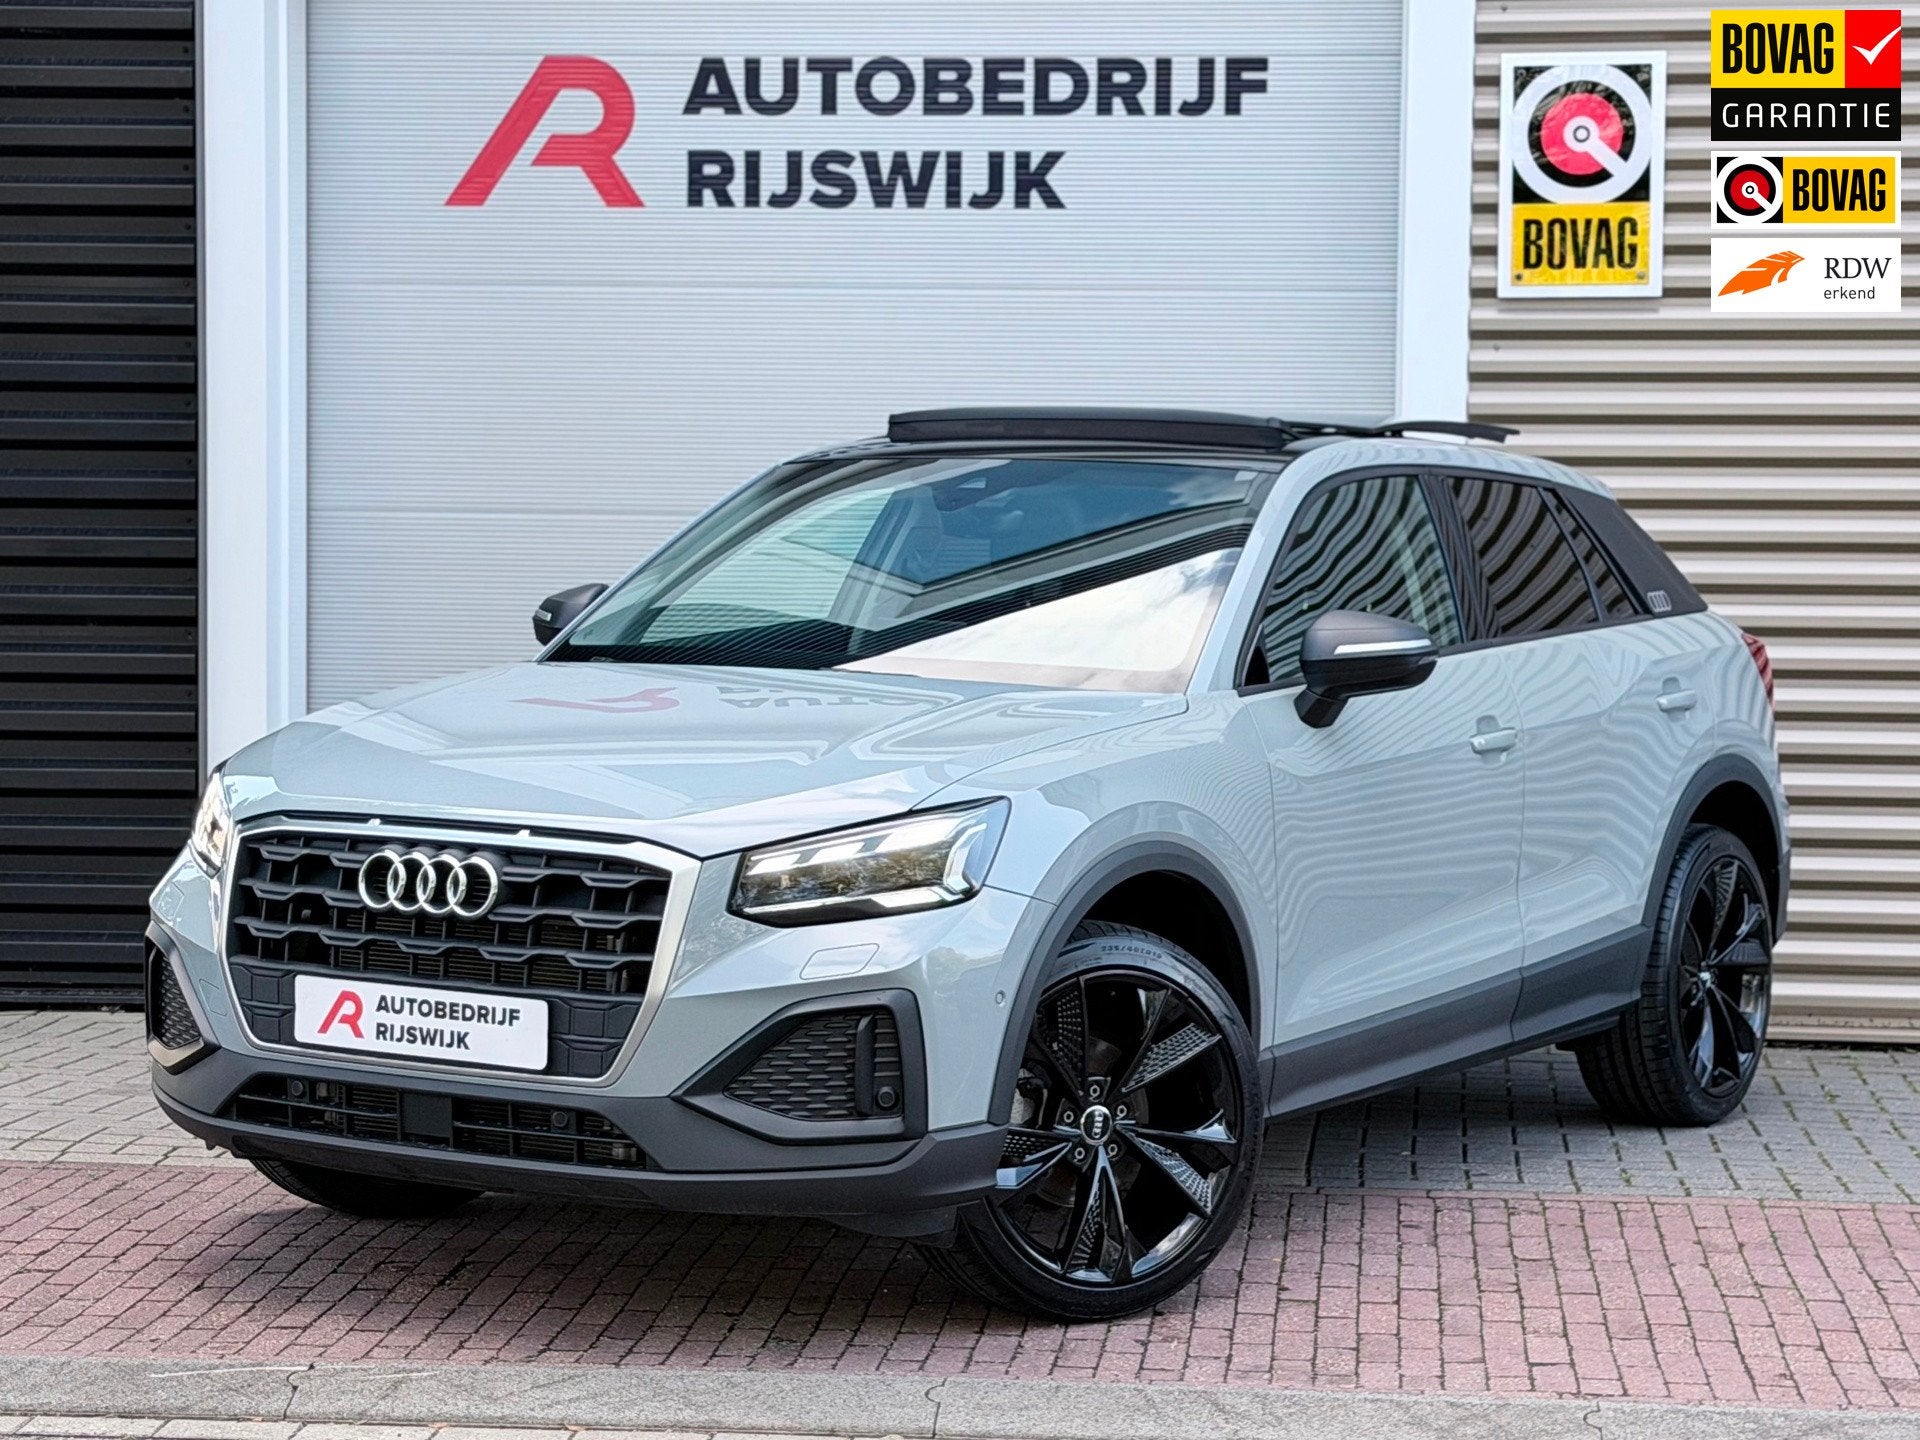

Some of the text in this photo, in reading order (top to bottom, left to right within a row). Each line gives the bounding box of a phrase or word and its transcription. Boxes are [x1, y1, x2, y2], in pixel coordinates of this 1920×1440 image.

[682, 56, 1269, 117] AUTOBEDRIJF
[687, 149, 1066, 210] RIJSWIJK
[1523, 217, 1638, 270] BOVAG
[375, 994, 521, 1027] AUTOBEDRIJF
[375, 1022, 471, 1050] RIJSWIJK
